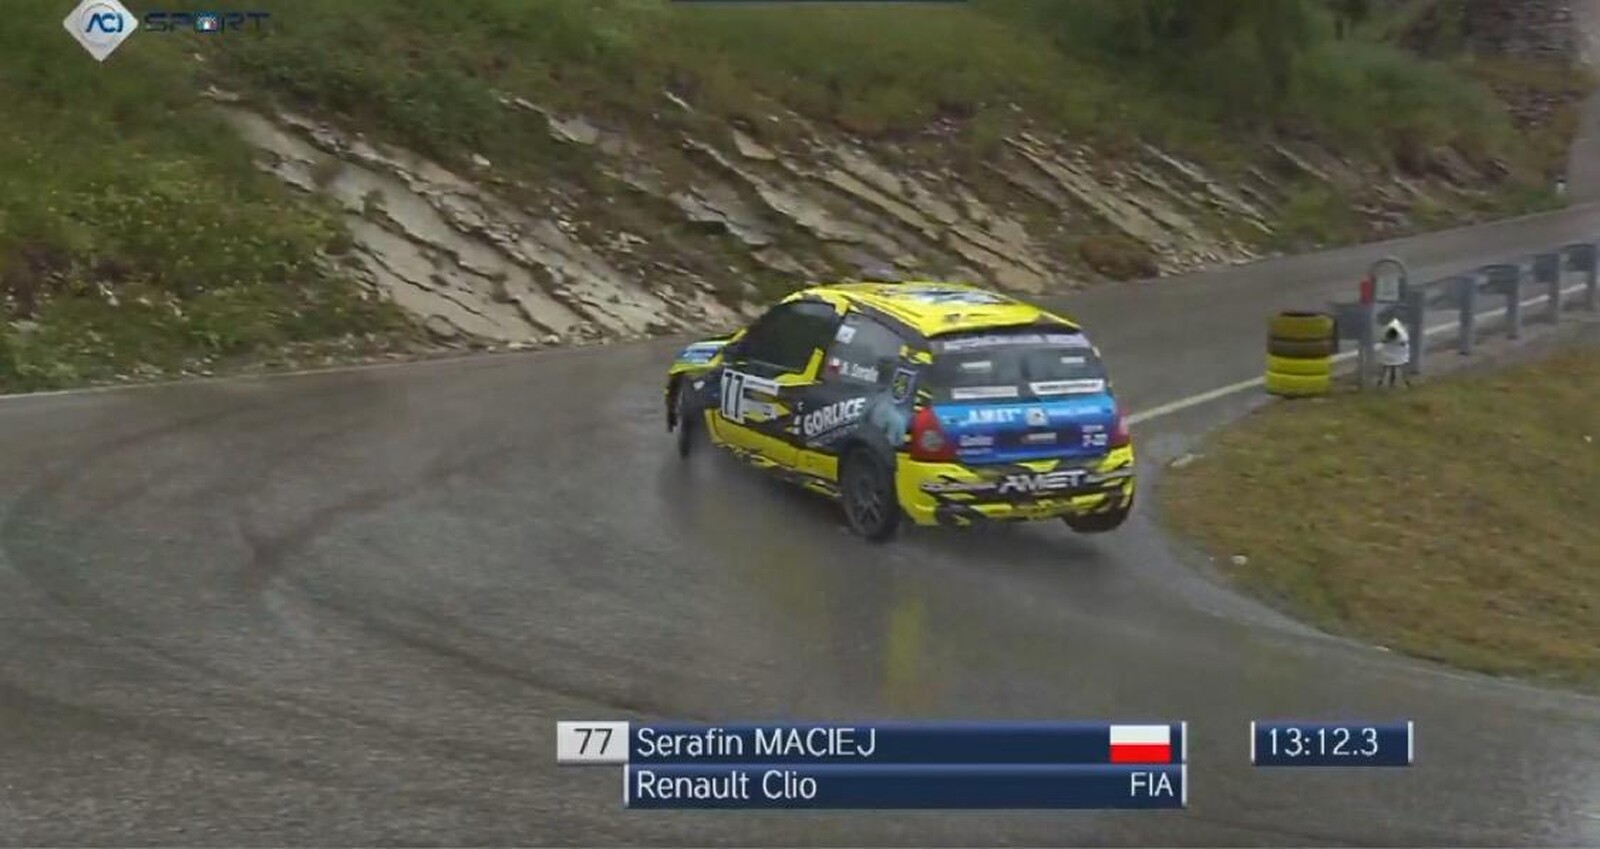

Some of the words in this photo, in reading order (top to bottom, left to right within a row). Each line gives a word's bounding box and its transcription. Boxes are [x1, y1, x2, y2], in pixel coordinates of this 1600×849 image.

[723, 371, 745, 419] 77
[803, 397, 866, 436] GORLICE
[999, 469, 1087, 494] AMET
